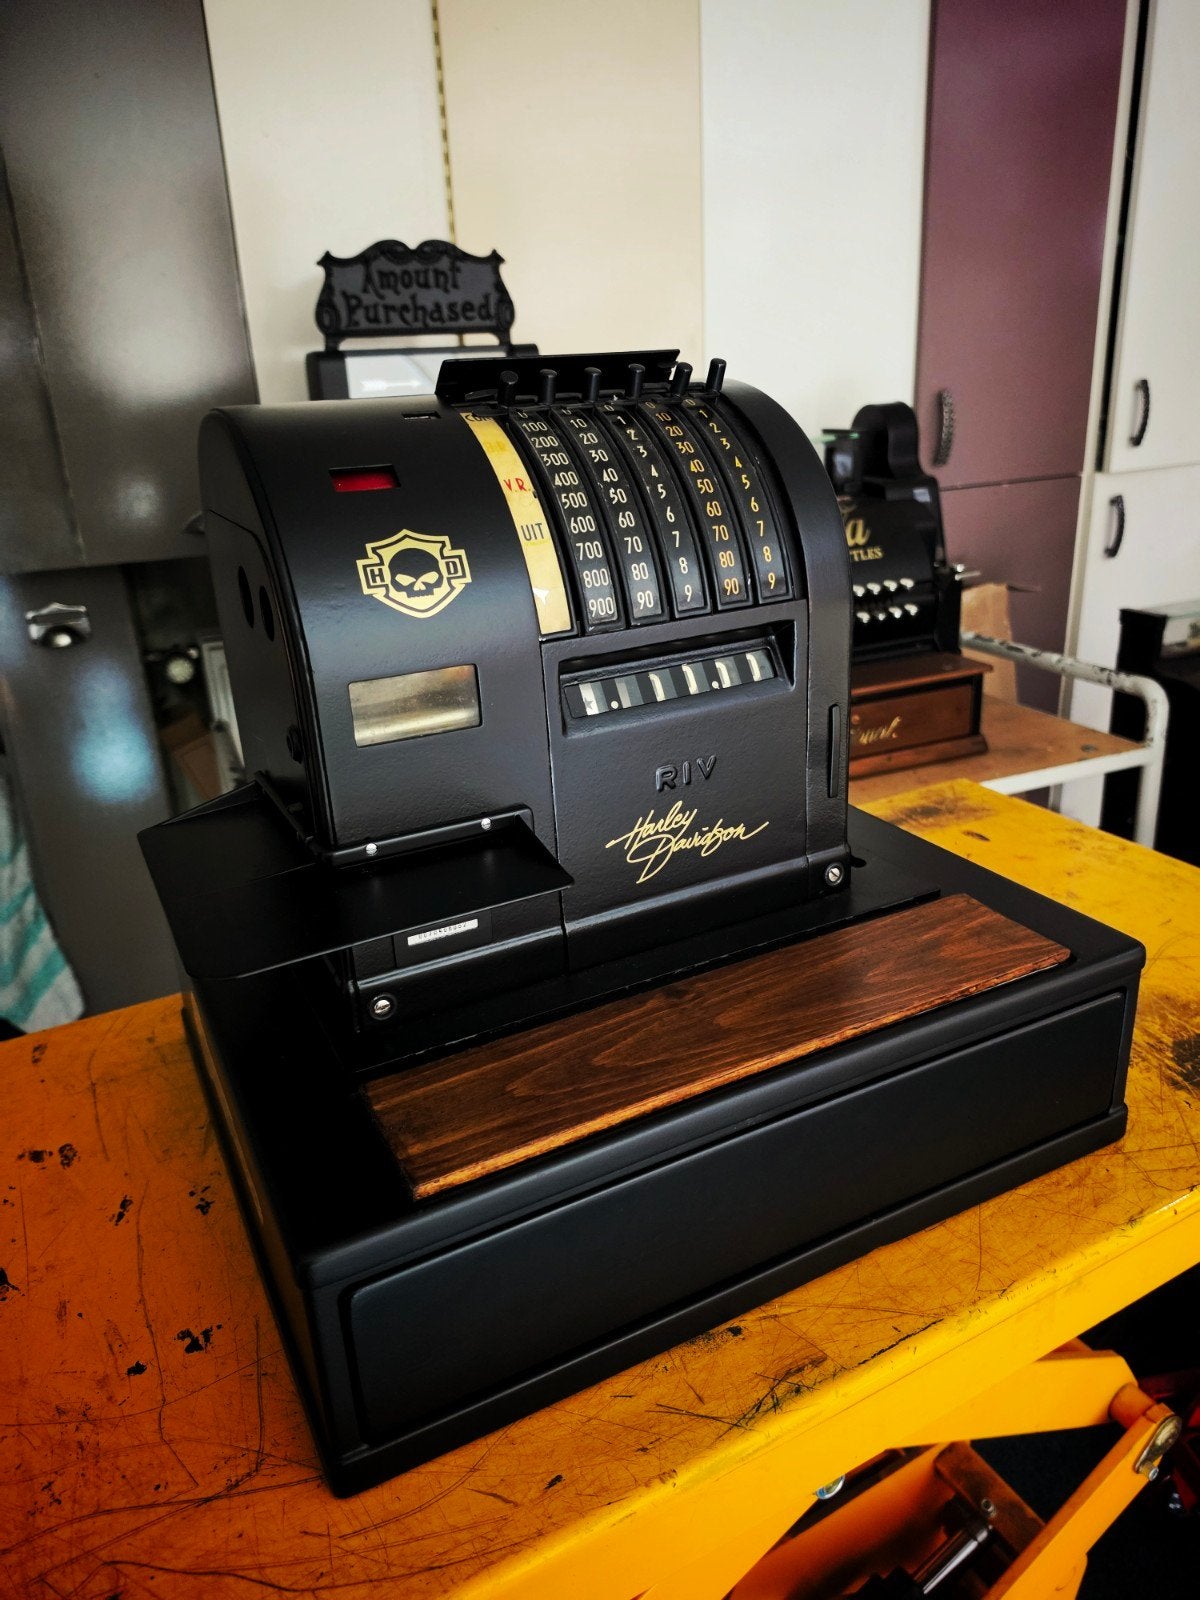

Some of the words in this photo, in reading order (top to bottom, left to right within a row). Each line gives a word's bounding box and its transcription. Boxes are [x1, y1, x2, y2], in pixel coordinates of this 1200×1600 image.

[362, 254, 461, 299] Amount
[340, 291, 494, 328] Purchased
[617, 416, 627, 425] 1
[656, 412, 672, 422] 10
[699, 409, 708, 419] 1
[522, 421, 548, 432] 100
[570, 418, 587, 428] 10
[666, 425, 683, 437] 20
[709, 422, 721, 433] 2
[531, 436, 559, 448] 200
[579, 432, 598, 445] 20
[626, 429, 638, 440] 2
[636, 445, 647, 458] 3
[675, 441, 695, 454] 30
[720, 438, 730, 450] 3
[541, 453, 569, 466] 300
[589, 449, 609, 463] 30
[735, 456, 743, 468] 4
[651, 464, 659, 478] 4
[690, 459, 705, 473] 40
[554, 471, 579, 486] 400
[602, 468, 618, 482] 40
[741, 474, 750, 490] 5
[657, 484, 666, 499] 5
[697, 478, 714, 494] 50
[562, 492, 588, 509] 500
[609, 487, 627, 504] 50
[750, 496, 759, 512] 6
[666, 506, 675, 523] 6
[706, 501, 722, 517] 60
[570, 515, 596, 534] 600
[618, 511, 635, 528] 60
[520, 522, 545, 541] UIT
[712, 524, 729, 542] 70
[756, 520, 764, 537] 7
[624, 536, 643, 554] 70
[672, 530, 680, 548] 7
[576, 541, 603, 560] 700
[719, 550, 735, 568] 80
[763, 545, 771, 562] 8
[370, 567, 385, 584] H
[445, 560, 458, 575] D
[631, 562, 649, 580] 80
[679, 557, 688, 574] 8
[583, 568, 610, 588] 800
[724, 577, 739, 596] 90
[768, 572, 776, 590] 9
[637, 590, 654, 609] 90
[684, 584, 692, 602] 9
[589, 597, 614, 617] 900
[655, 755, 717, 792] RIV
[605, 800, 697, 850] Harley
[626, 819, 770, 884] Davidson
